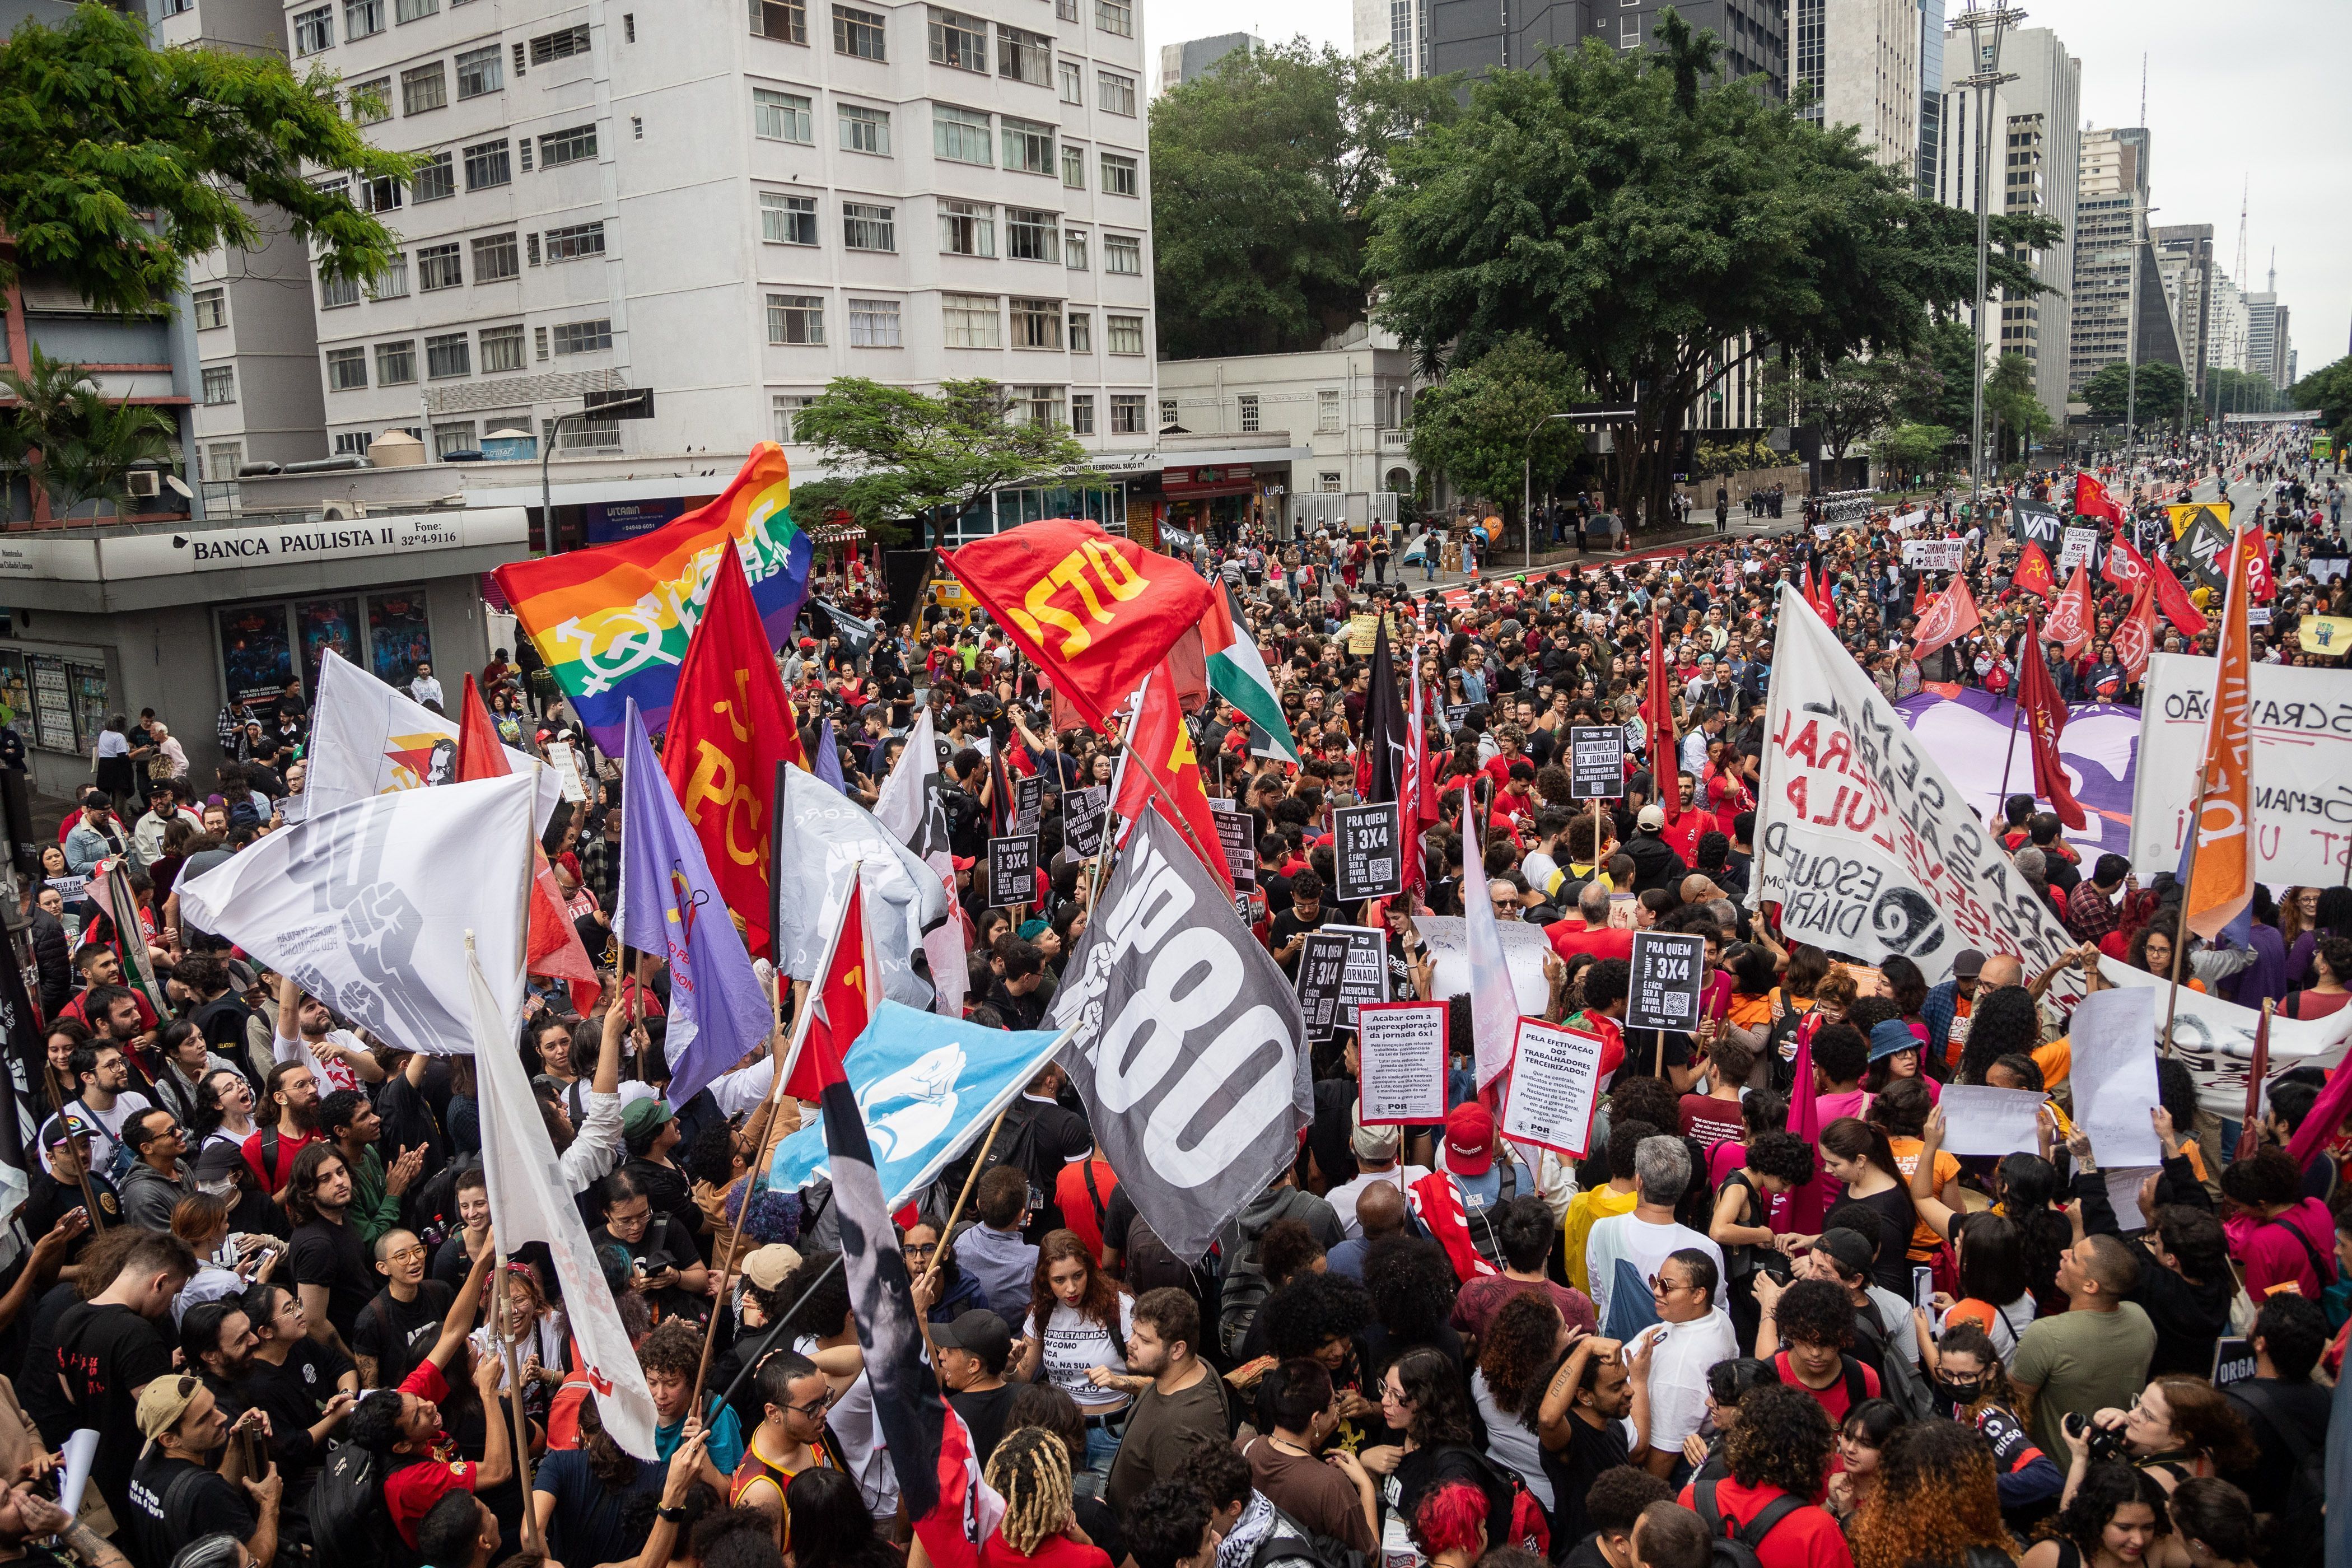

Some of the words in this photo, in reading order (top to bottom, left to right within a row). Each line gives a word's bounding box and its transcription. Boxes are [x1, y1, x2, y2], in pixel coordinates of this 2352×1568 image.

[1264, 485, 1283, 497] LUPO
[608, 506, 640, 516] VITAMIN
[415, 522, 441, 531] Fone:
[2020, 514, 2060, 542] VAT
[1161, 528, 1189, 546] VAT
[2067, 528, 2095, 538] REDUÇÃO
[194, 537, 270, 560] BANCA
[281, 530, 374, 553] PAULISTA
[381, 528, 394, 543] II
[1925, 544, 1947, 554] JORNAD
[1578, 741, 1617, 752] DIMINUIÇÃO
[1578, 756, 1586, 764] DA
[1588, 754, 1618, 764] JORNADA
[1071, 796, 1084, 809] QUE
[1065, 803, 1105, 830] CAPITALISTAS
[1347, 815, 1363, 827] PRA
[1365, 812, 1388, 827] QUEM
[1071, 823, 1093, 837] PAGUEM
[1216, 820, 1231, 830] ESCALA
[1232, 823, 1241, 831] 6X1
[1218, 829, 1243, 840] ESCRAVIDÃO
[1359, 827, 1388, 849] 3X4
[997, 844, 1010, 853] PRA
[1011, 841, 1028, 852] QUEM
[1079, 833, 1101, 851] CONTA
[1007, 852, 1028, 869] 3X4
[1353, 852, 1368, 861] FÁCIL
[1313, 944, 1326, 957] PRA
[1327, 945, 1343, 959] QUEM
[1646, 941, 1664, 954] PRA
[1666, 943, 1691, 956] QUEM
[1317, 962, 1338, 985] 3X4
[1344, 969, 1378, 981] JORNADA
[1656, 958, 1689, 980] 3X4
[1345, 986, 1368, 996] REDUÇÃO
[1648, 981, 1663, 990] FÁCIL
[1366, 1021, 1438, 1031] superexploração
[1383, 1032, 1416, 1040] jornada
[1526, 1034, 1544, 1043] PELA
[1547, 1039, 1594, 1054] EFETIVAÇÃO
[1095, 926, 1297, 1188] 80
[1524, 1049, 1590, 1070] TRABALHADORES
[1525, 1056, 1587, 1077] TERCEIRIZADOS!
[1520, 1074, 1547, 1085] sindicatos
[1553, 1082, 1585, 1094] movimentos
[1552, 1075, 1575, 1085] centrais,
[1527, 1082, 1557, 1093] convoquem
[1527, 1088, 1550, 1098] Nacional
[1520, 1092, 1543, 1103] Preparar
[1565, 1103, 1579, 1112] geral,
[1523, 1106, 1550, 1117] empregos,
[1551, 1113, 1572, 1122] salários
[1538, 1117, 1560, 1125] direitos!
[1530, 1123, 1550, 1133] POR
[1452, 1143, 1482, 1155] Compton
[1048, 1331, 1107, 1340] PROLETARIADO
[2220, 1356, 2257, 1383] ORGA
[1994, 1429, 2022, 1457] Bitso
